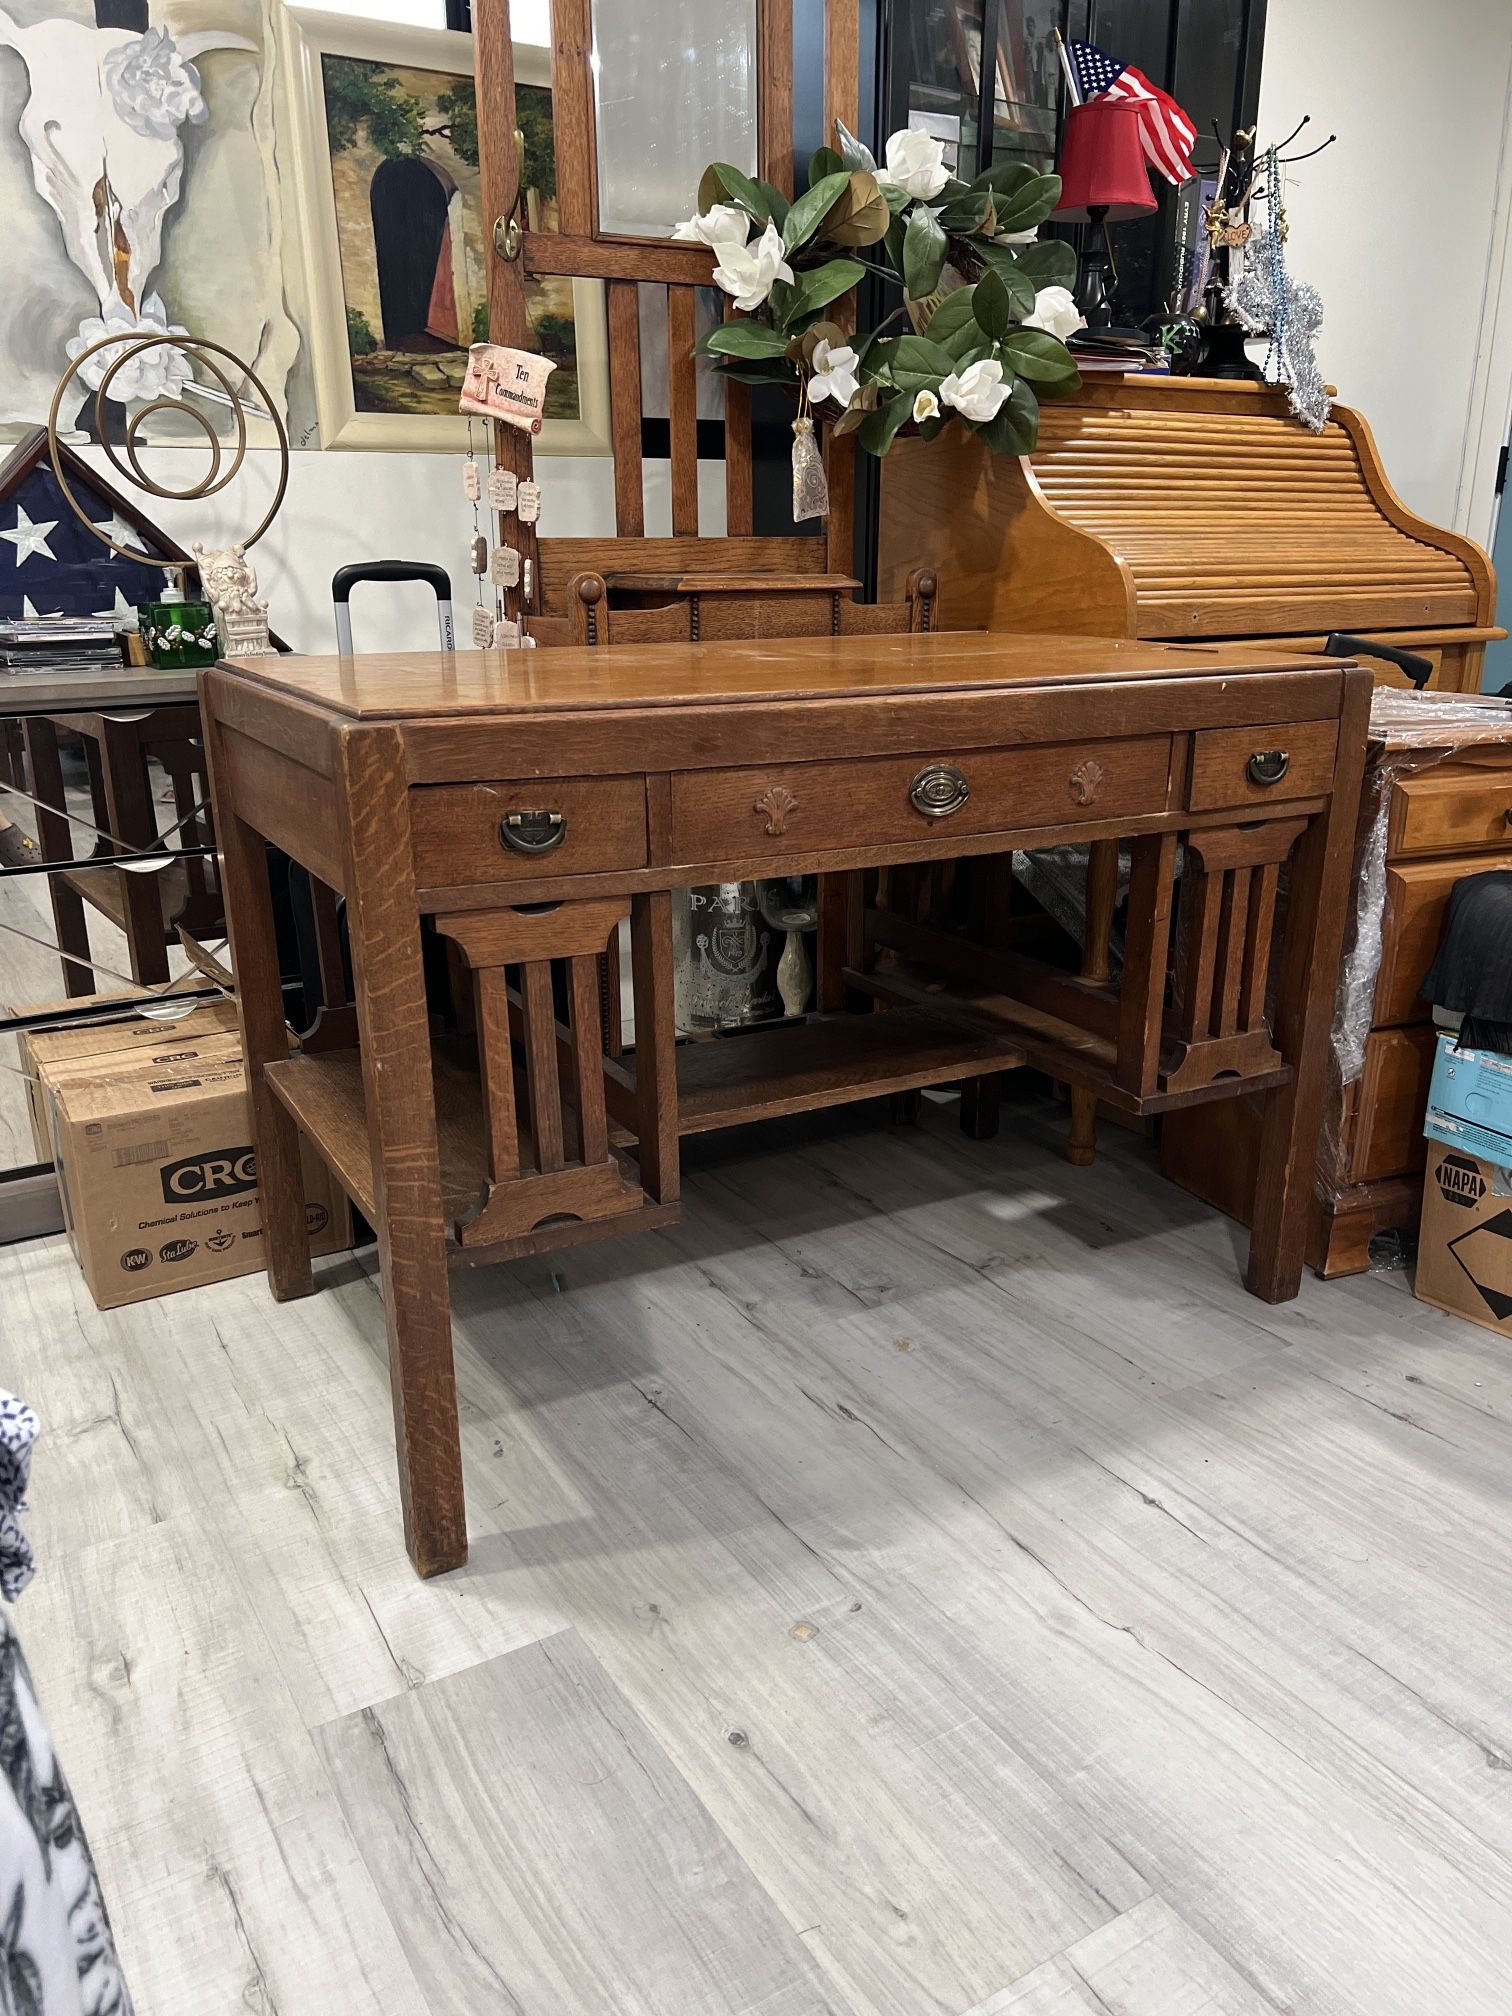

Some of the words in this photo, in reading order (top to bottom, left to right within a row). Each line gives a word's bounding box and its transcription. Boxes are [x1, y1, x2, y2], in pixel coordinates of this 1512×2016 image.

[1227, 229, 1247, 242] LOVE
[515, 363, 530, 382] Ten
[495, 383, 539, 409] Commandments
[444, 615, 453, 651] RICARD
[169, 1153, 257, 1195] CRC
[1442, 1165, 1478, 1197] NAPA
[138, 1214, 178, 1230] Chemical
[179, 1207, 219, 1221] Solutions
[220, 1203, 230, 1212] to
[232, 1199, 253, 1210] Keep
